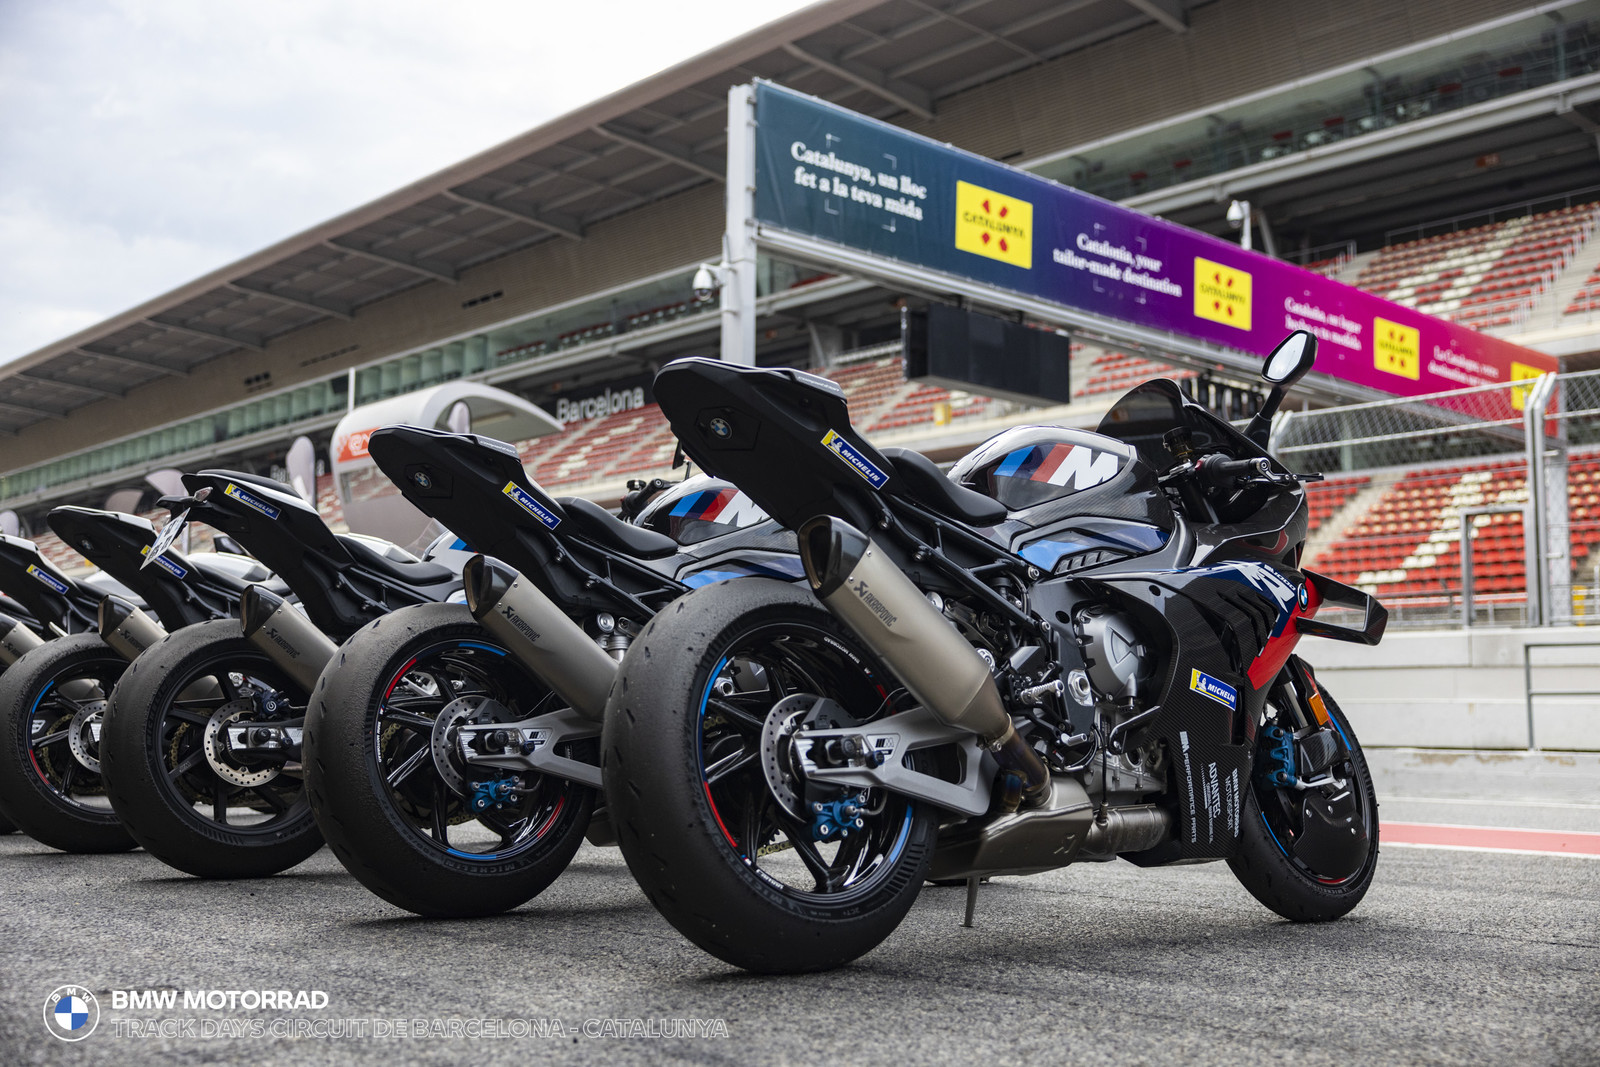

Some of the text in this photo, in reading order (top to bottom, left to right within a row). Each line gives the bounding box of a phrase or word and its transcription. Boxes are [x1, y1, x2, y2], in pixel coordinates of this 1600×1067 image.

[791, 141, 927, 199] Catalunya, un lloc
[794, 166, 923, 221] fet a la teva mida
[963, 211, 1026, 239] CATALUNYA
[1076, 233, 1163, 272] Catalonia, your
[1052, 248, 1182, 298] tailor-made destination
[556, 386, 645, 424] Barcelona
[841, 449, 881, 483] MICHELIN
[241, 494, 274, 515] MICHELIN
[519, 496, 554, 524] MICHELIN
[1207, 683, 1236, 703] MICHELIN
[1183, 753, 1196, 816] PERFORMANCE
[1208, 761, 1221, 819] ADVANTEC
